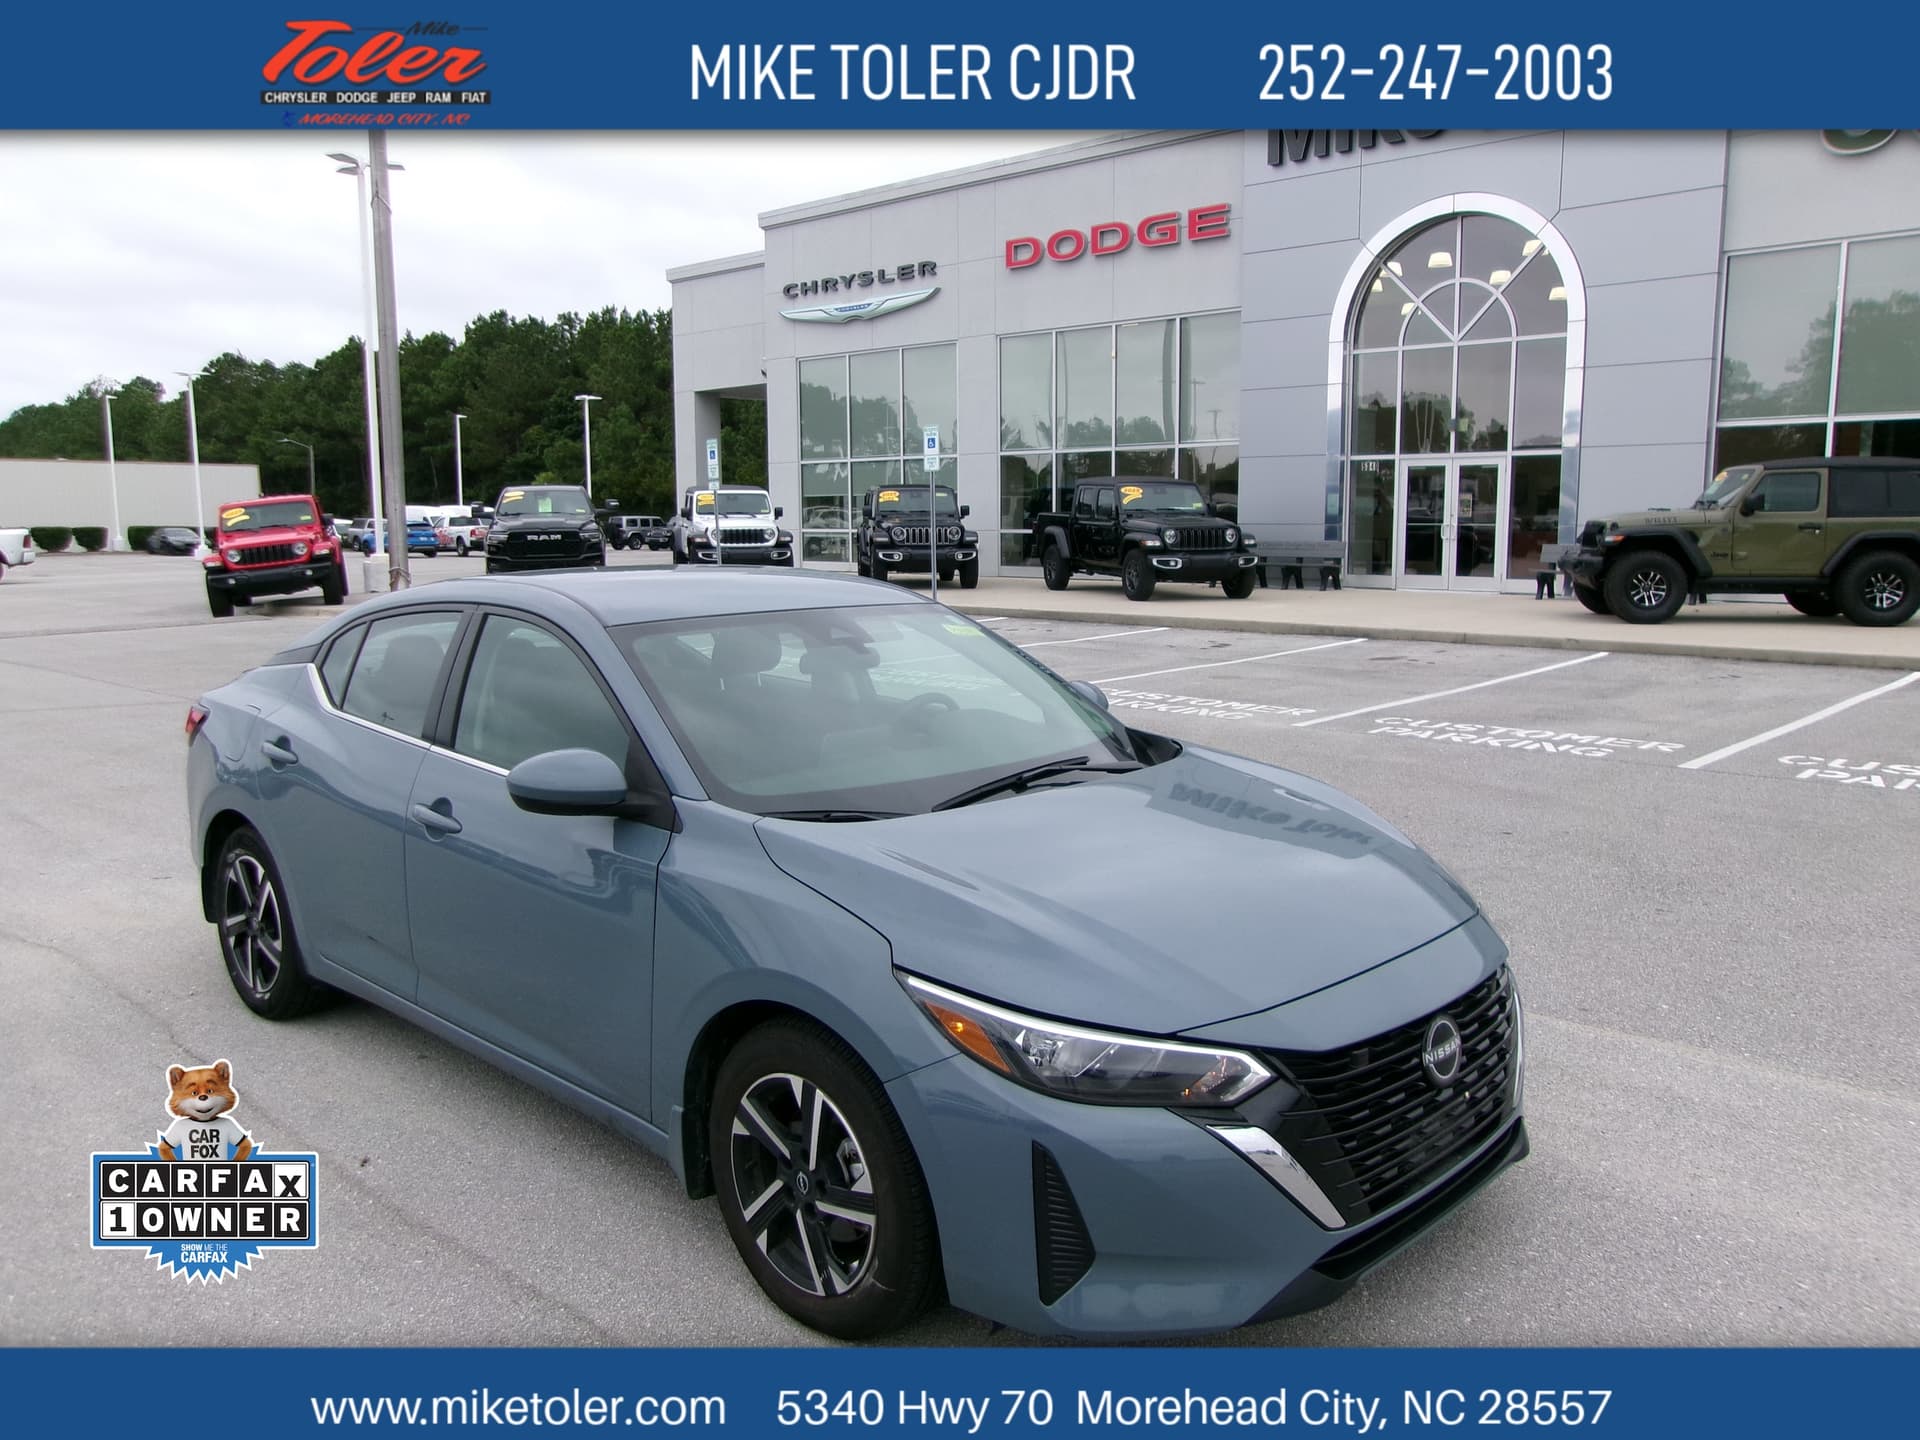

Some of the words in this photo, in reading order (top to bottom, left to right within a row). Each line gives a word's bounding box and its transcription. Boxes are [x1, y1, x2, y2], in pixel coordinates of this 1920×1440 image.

[1004, 202, 1231, 270] DODGE
[782, 260, 938, 299] CHRYSLER
[1367, 726, 1615, 757] PARKING
[1374, 716, 1686, 752] CUSTOMER
[1422, 1036, 1460, 1067] NISSAN
